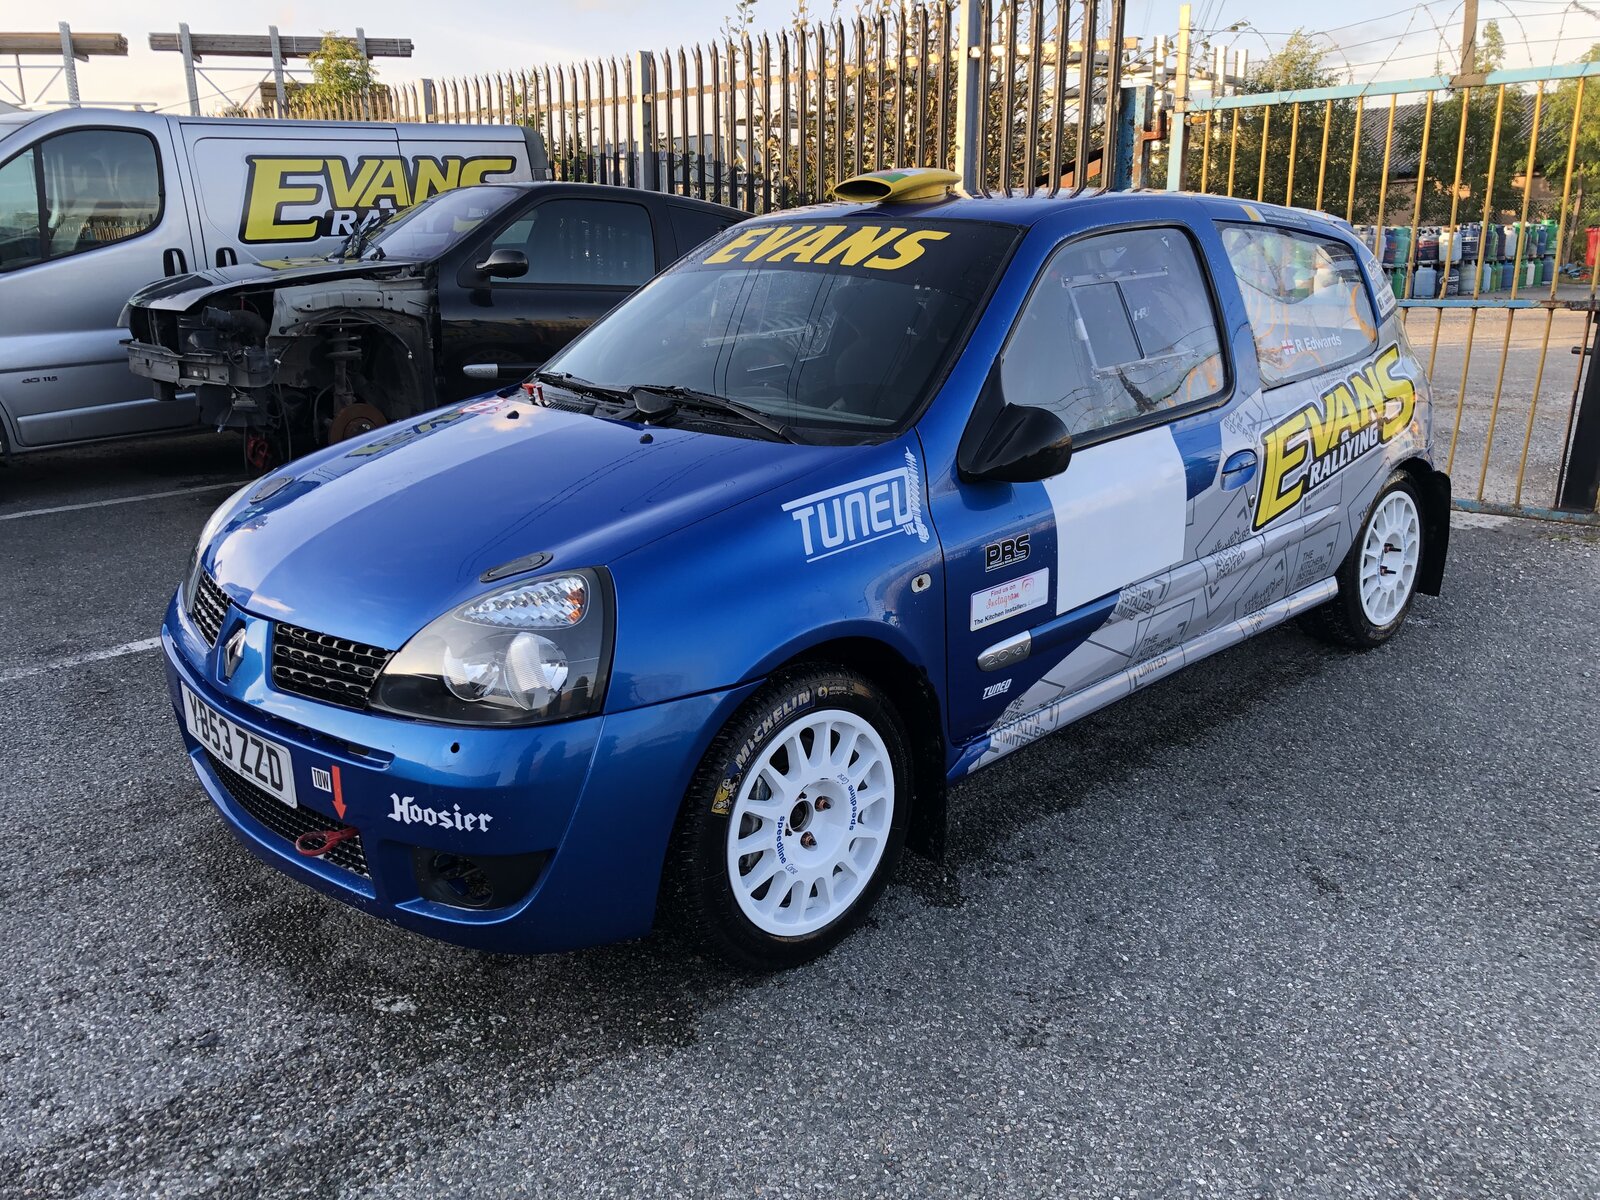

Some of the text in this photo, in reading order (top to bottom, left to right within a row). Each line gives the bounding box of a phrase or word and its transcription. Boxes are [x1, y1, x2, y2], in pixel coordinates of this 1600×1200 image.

[703, 225, 951, 270] EVANS
[1295, 333, 1342, 352] R Edwards
[1253, 343, 1415, 531] EVANS
[1309, 421, 1379, 488] RALLYING
[781, 466, 915, 556] TUNED
[903, 522, 917, 536] UK
[986, 592, 1020, 609] Instagram
[990, 587, 1002, 596] Find
[984, 610, 1004, 621] Kitchen
[1005, 603, 1027, 615] Installers
[985, 649, 1009, 667] 2.0
[1138, 655, 1168, 678] LIMITED
[983, 678, 1013, 698] TUNED
[187, 690, 284, 792] YB53 ZZD
[734, 689, 811, 770] MICHELIN
[312, 768, 330, 790] TOW
[387, 792, 493, 833] Hoosier
[847, 784, 858, 831] speedline
[776, 815, 787, 864] speedline
